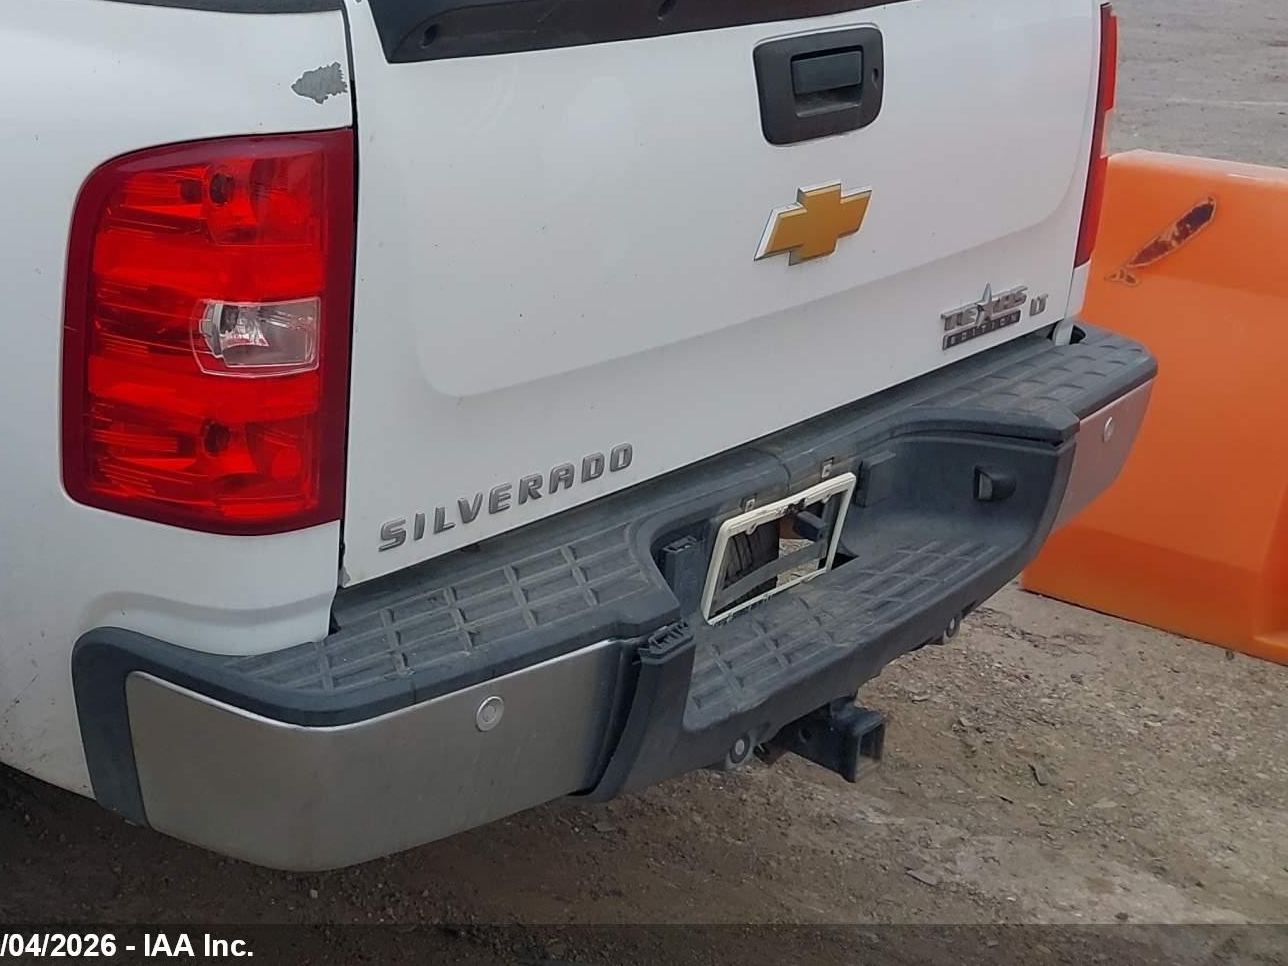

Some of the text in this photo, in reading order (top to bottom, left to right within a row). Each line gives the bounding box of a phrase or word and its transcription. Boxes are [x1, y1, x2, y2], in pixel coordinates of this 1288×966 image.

[1029, 292, 1049, 316] LT
[948, 313, 1019, 347] EDITION
[378, 442, 634, 552] SILVERADO
